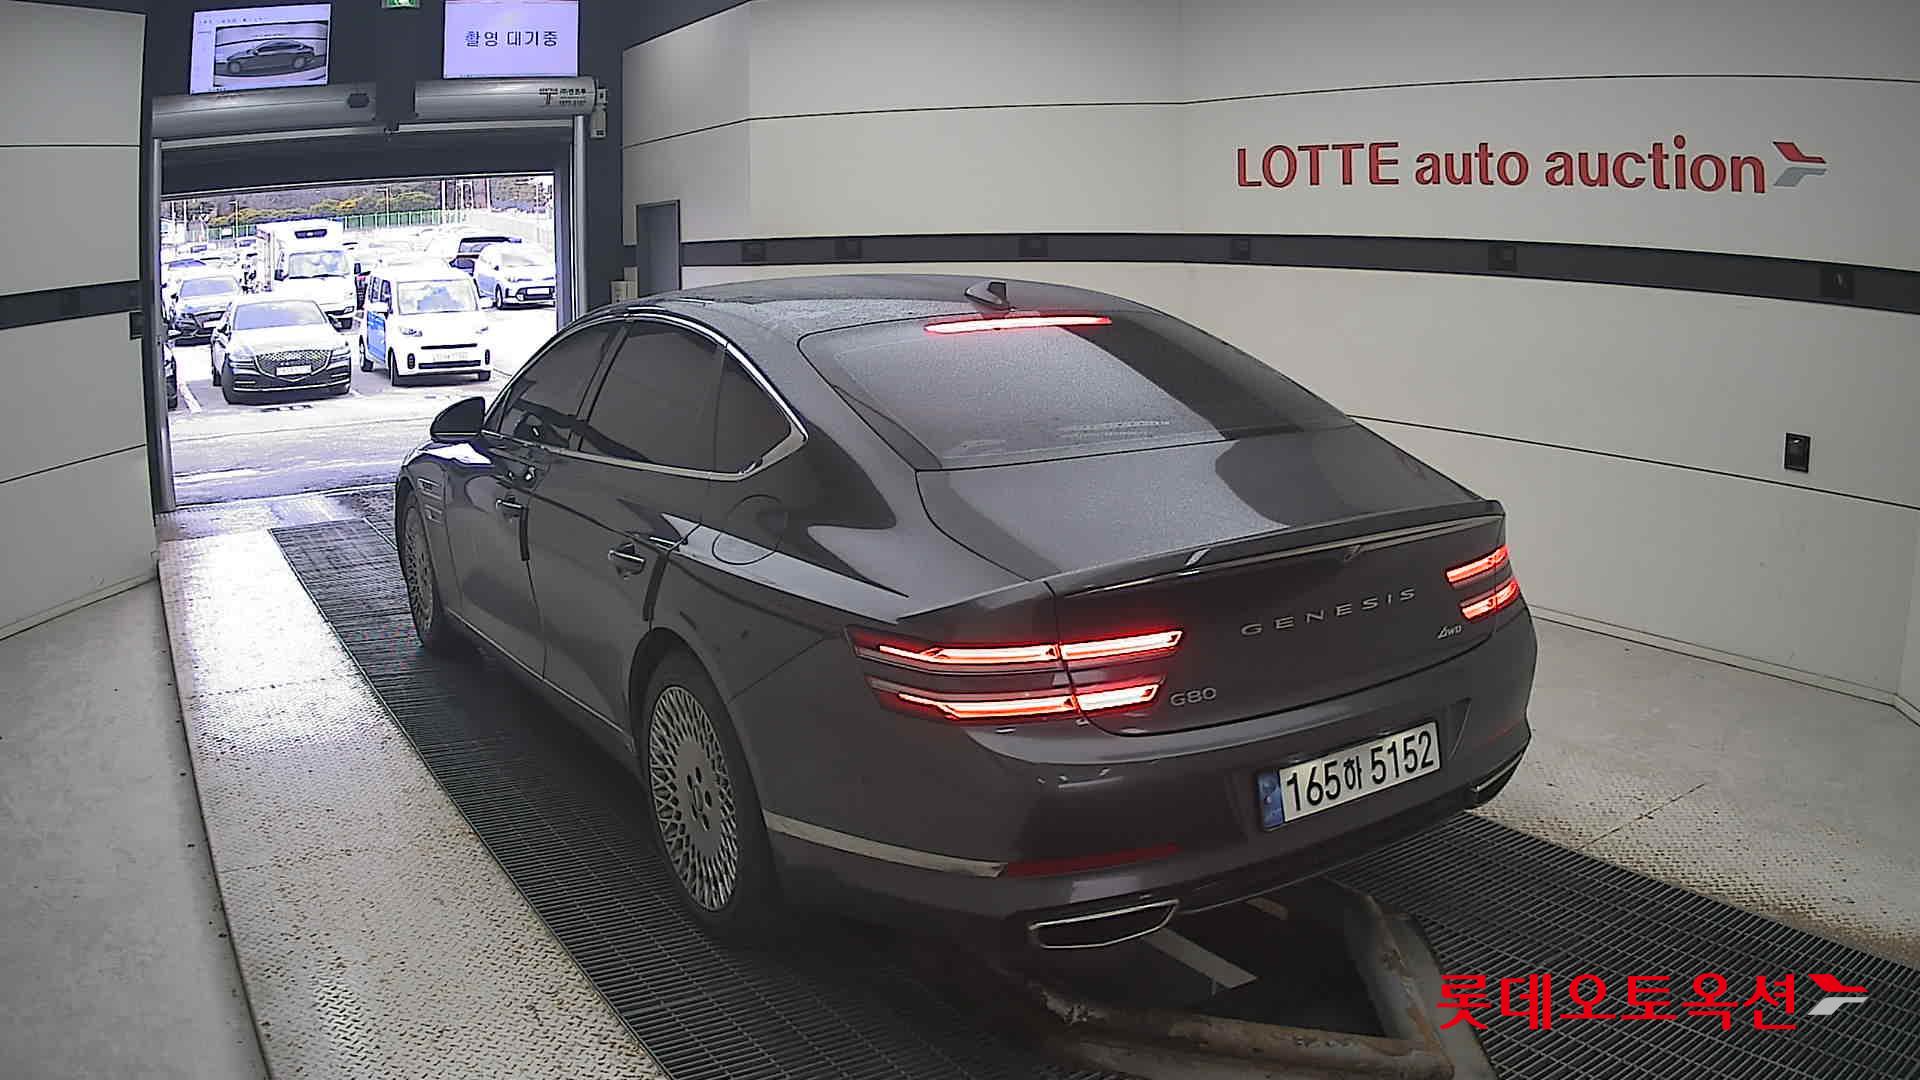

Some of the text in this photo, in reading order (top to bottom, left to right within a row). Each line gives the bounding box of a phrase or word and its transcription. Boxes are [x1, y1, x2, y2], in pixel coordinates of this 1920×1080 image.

[507, 31, 558, 47] 대기중
[1236, 134, 1767, 194] LOTTE auto auction
[1241, 587, 1415, 636] GENESIS
[1170, 687, 1217, 706] G80
[1286, 730, 1435, 811] 165하 5152
